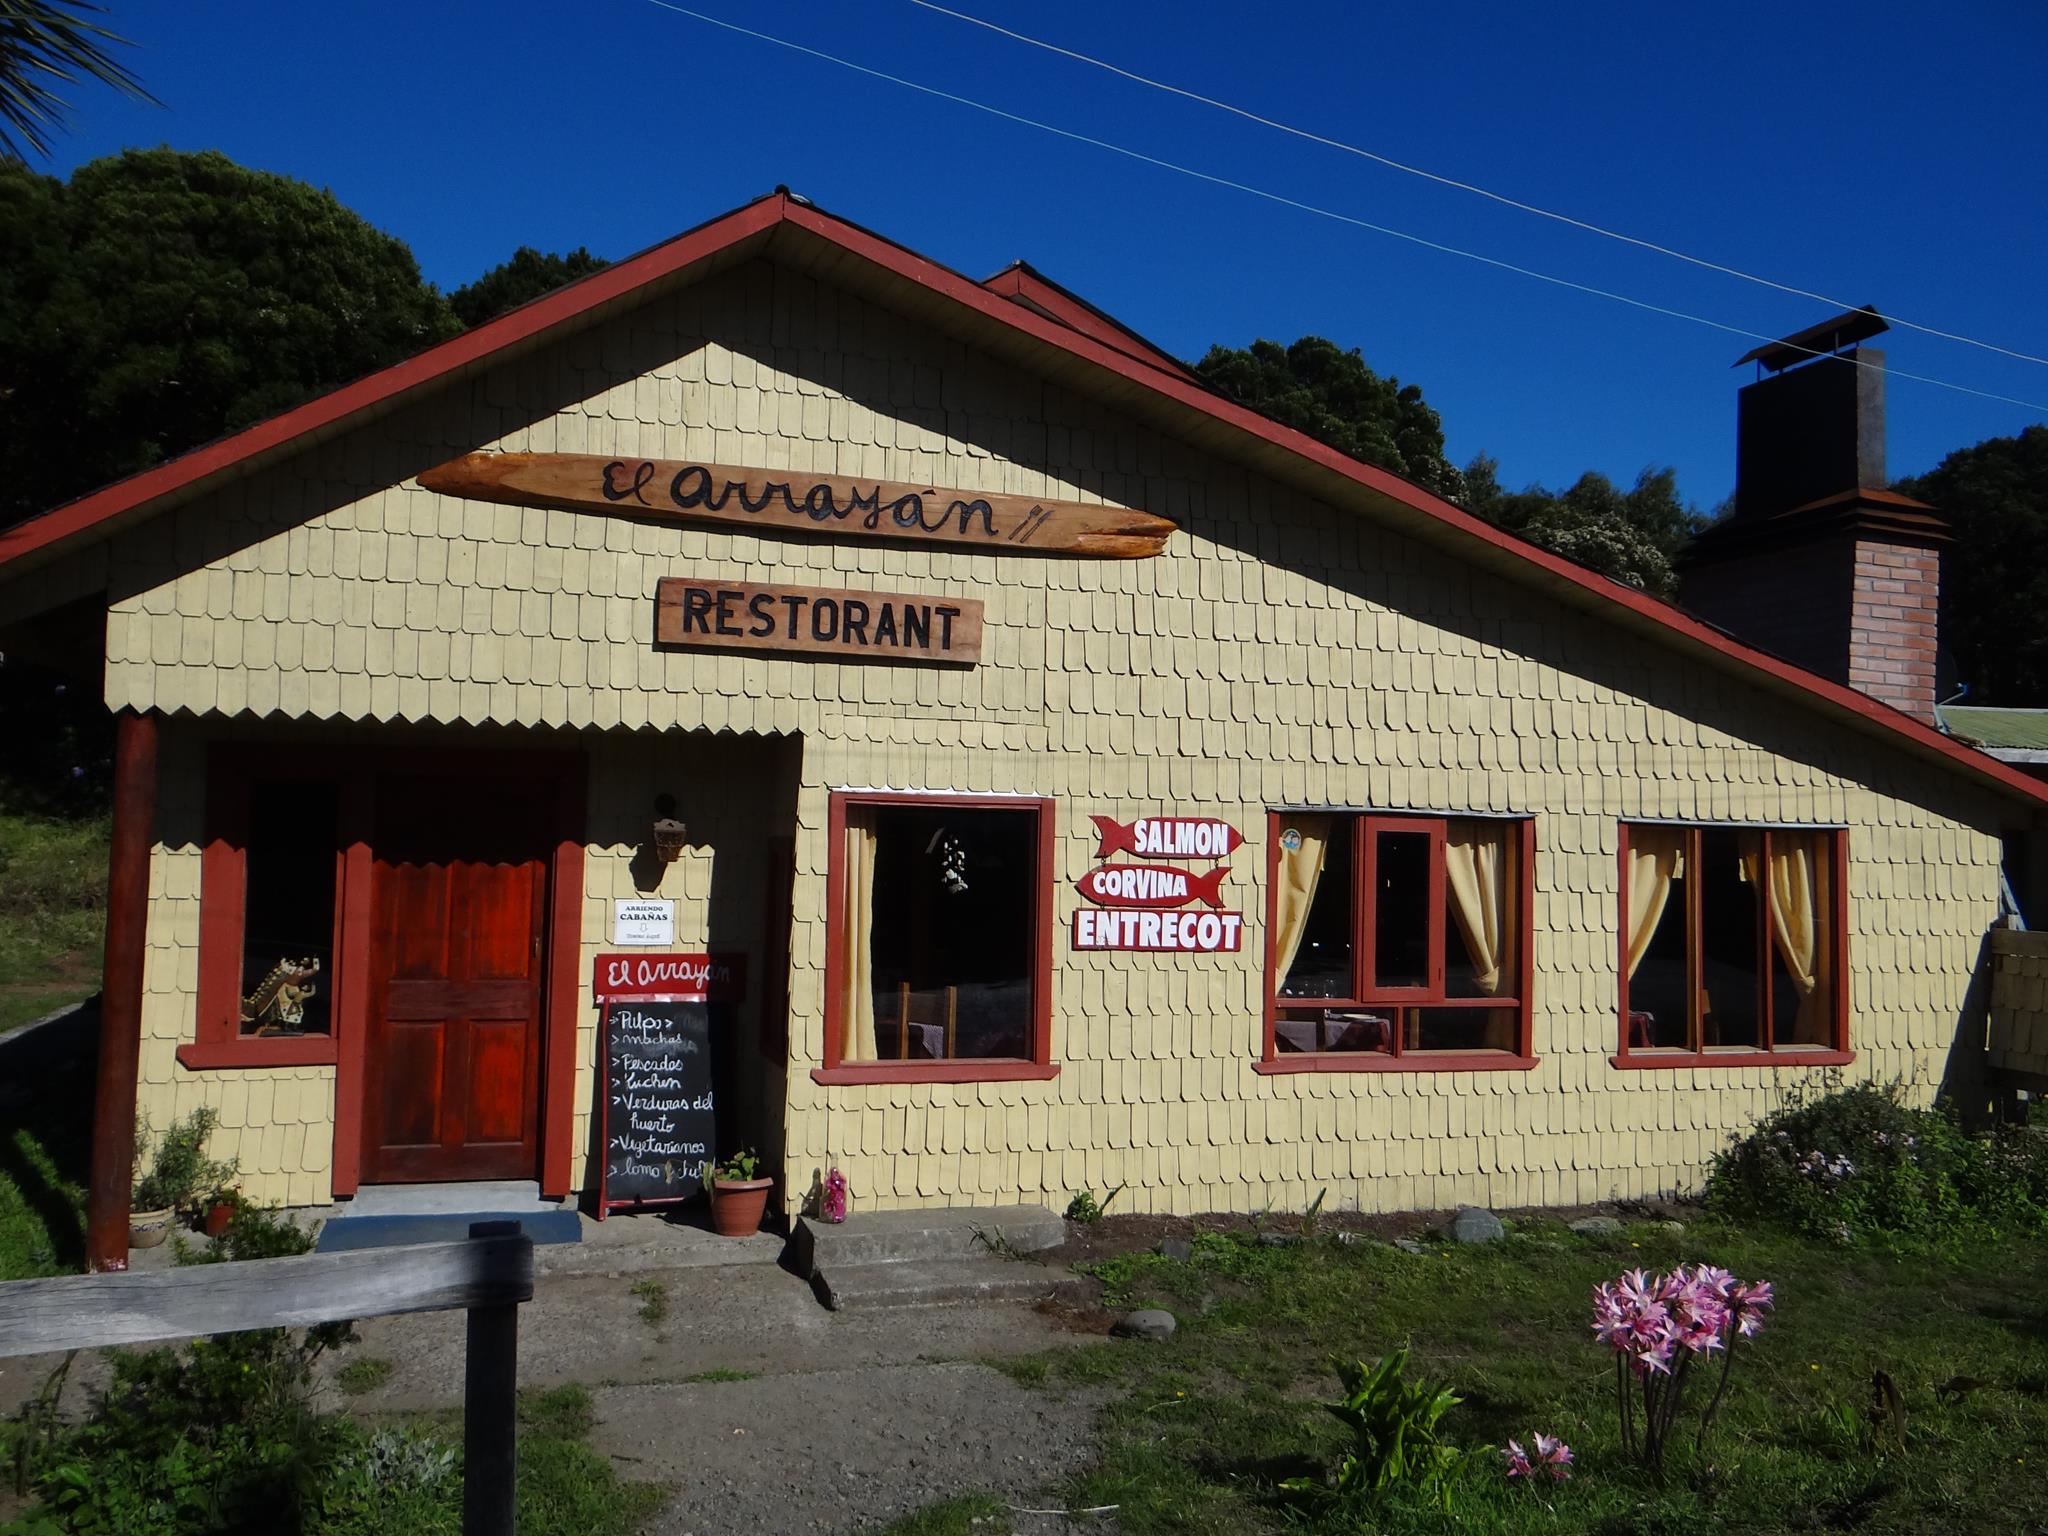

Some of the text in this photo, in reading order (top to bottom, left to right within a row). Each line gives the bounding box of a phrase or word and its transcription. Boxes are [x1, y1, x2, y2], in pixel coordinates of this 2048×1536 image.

[602, 460, 655, 506] El
[682, 587, 961, 651] RESTORANT
[1133, 819, 1229, 856] SALMON
[1092, 868, 1188, 900] CORVINA
[619, 911, 668, 921] CABAÑAS
[1077, 910, 1240, 949] ENTRECOT
[608, 960, 634, 986] El
[622, 1091, 713, 1111] Verduras del
[630, 1112, 675, 1133] huerto
